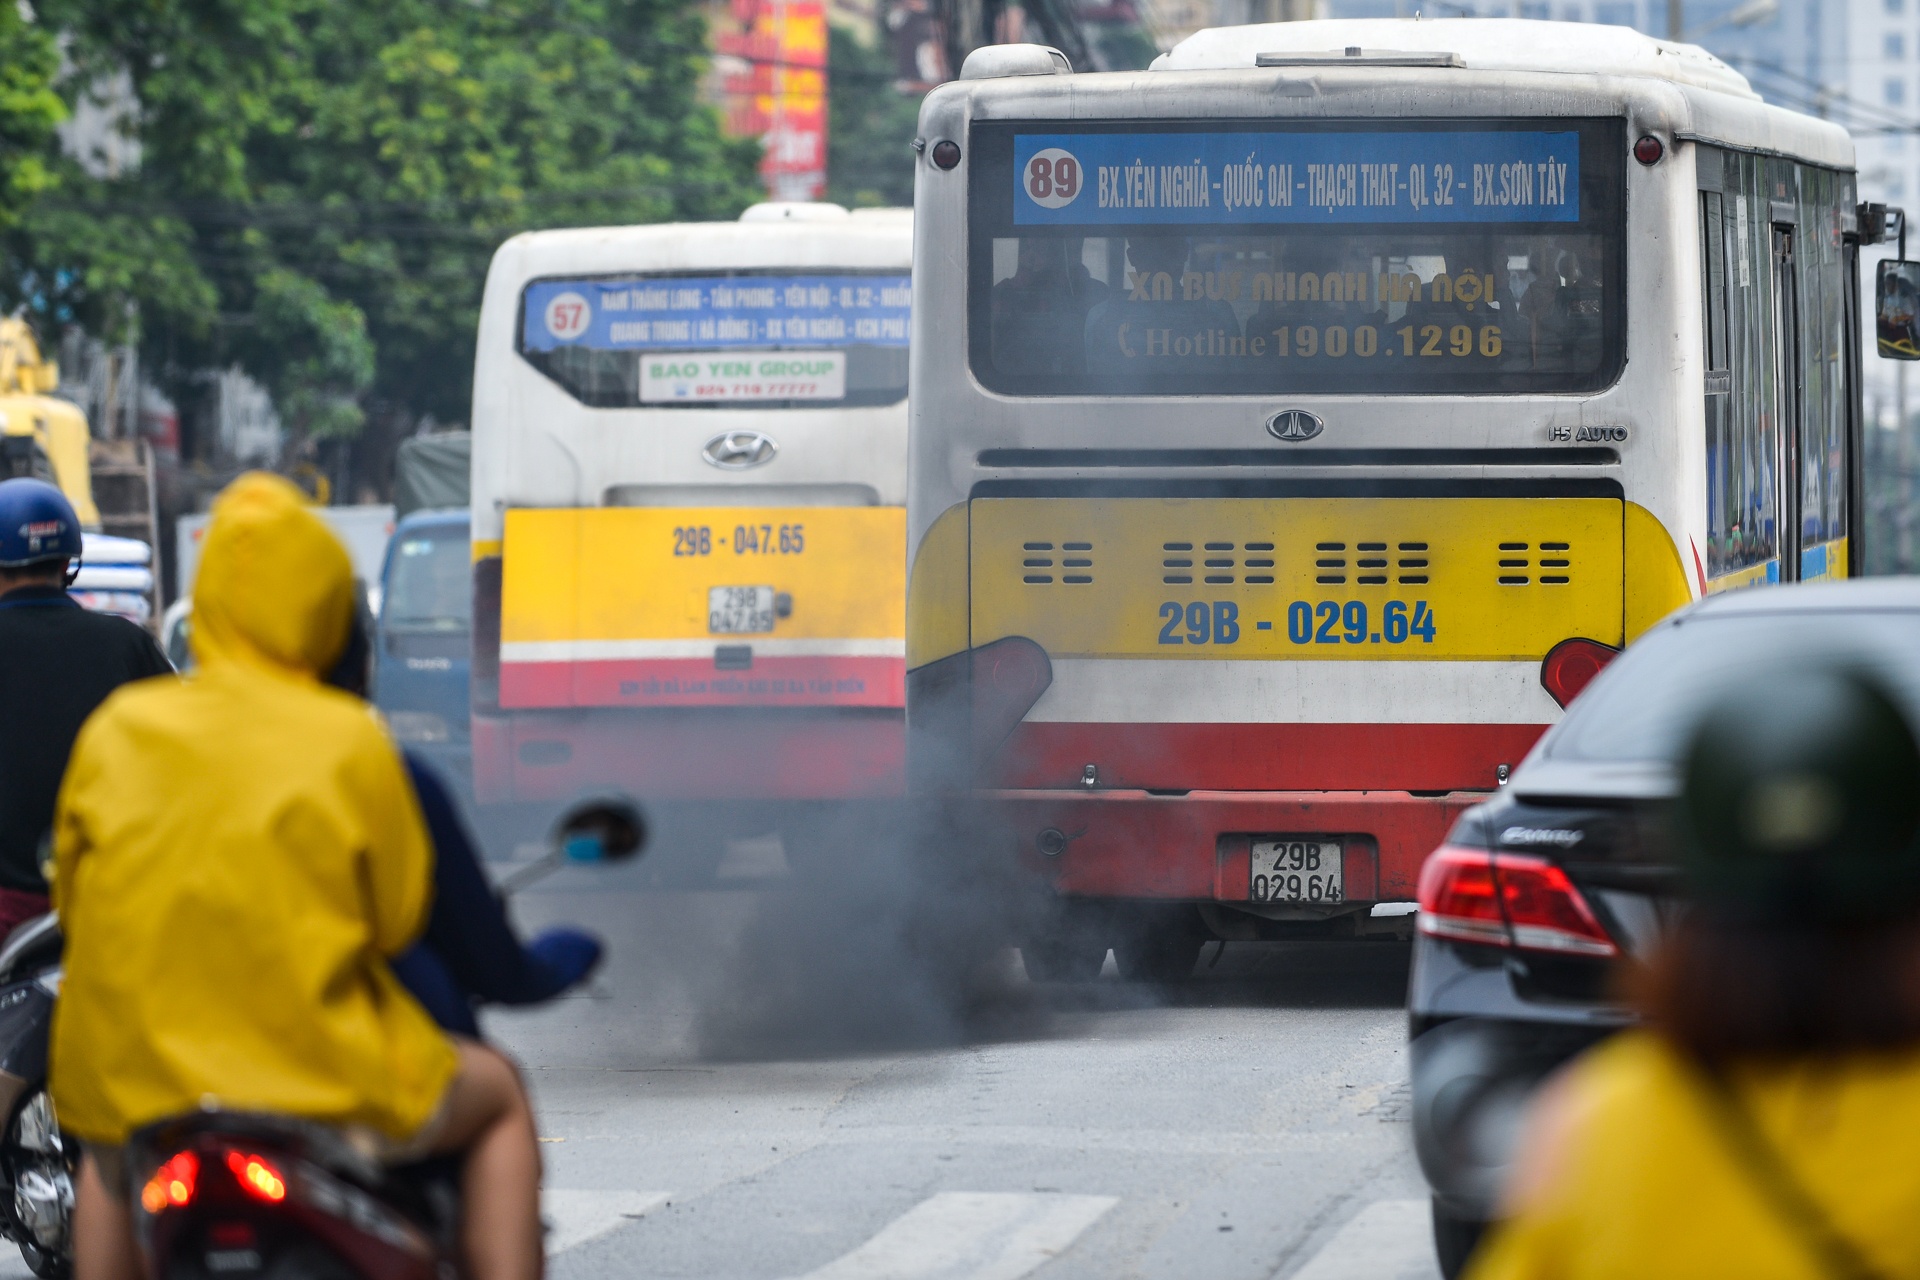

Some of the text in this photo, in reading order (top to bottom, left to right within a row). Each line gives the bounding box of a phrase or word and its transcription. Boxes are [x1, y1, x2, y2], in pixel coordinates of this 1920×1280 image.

[1029, 156, 1077, 199] 89
[1098, 151, 1567, 213] BX.YÊN NGHĨA QUỐC OAI THẠCH THAT QL 32 BX.SƠN TÂY
[856, 286, 873, 308] 32
[1432, 267, 1494, 312] NỘI
[553, 303, 583, 331] 57
[1144, 324, 1502, 357] Hotline 1900.1296
[650, 360, 835, 379] BAO YEN GROUP
[1575, 425, 1629, 442] AUTO
[673, 523, 804, 556] 29B 047.65
[1158, 600, 1437, 645] 29B 029.64
[1272, 842, 1322, 872] 29B
[1253, 873, 1341, 903] 029.64
